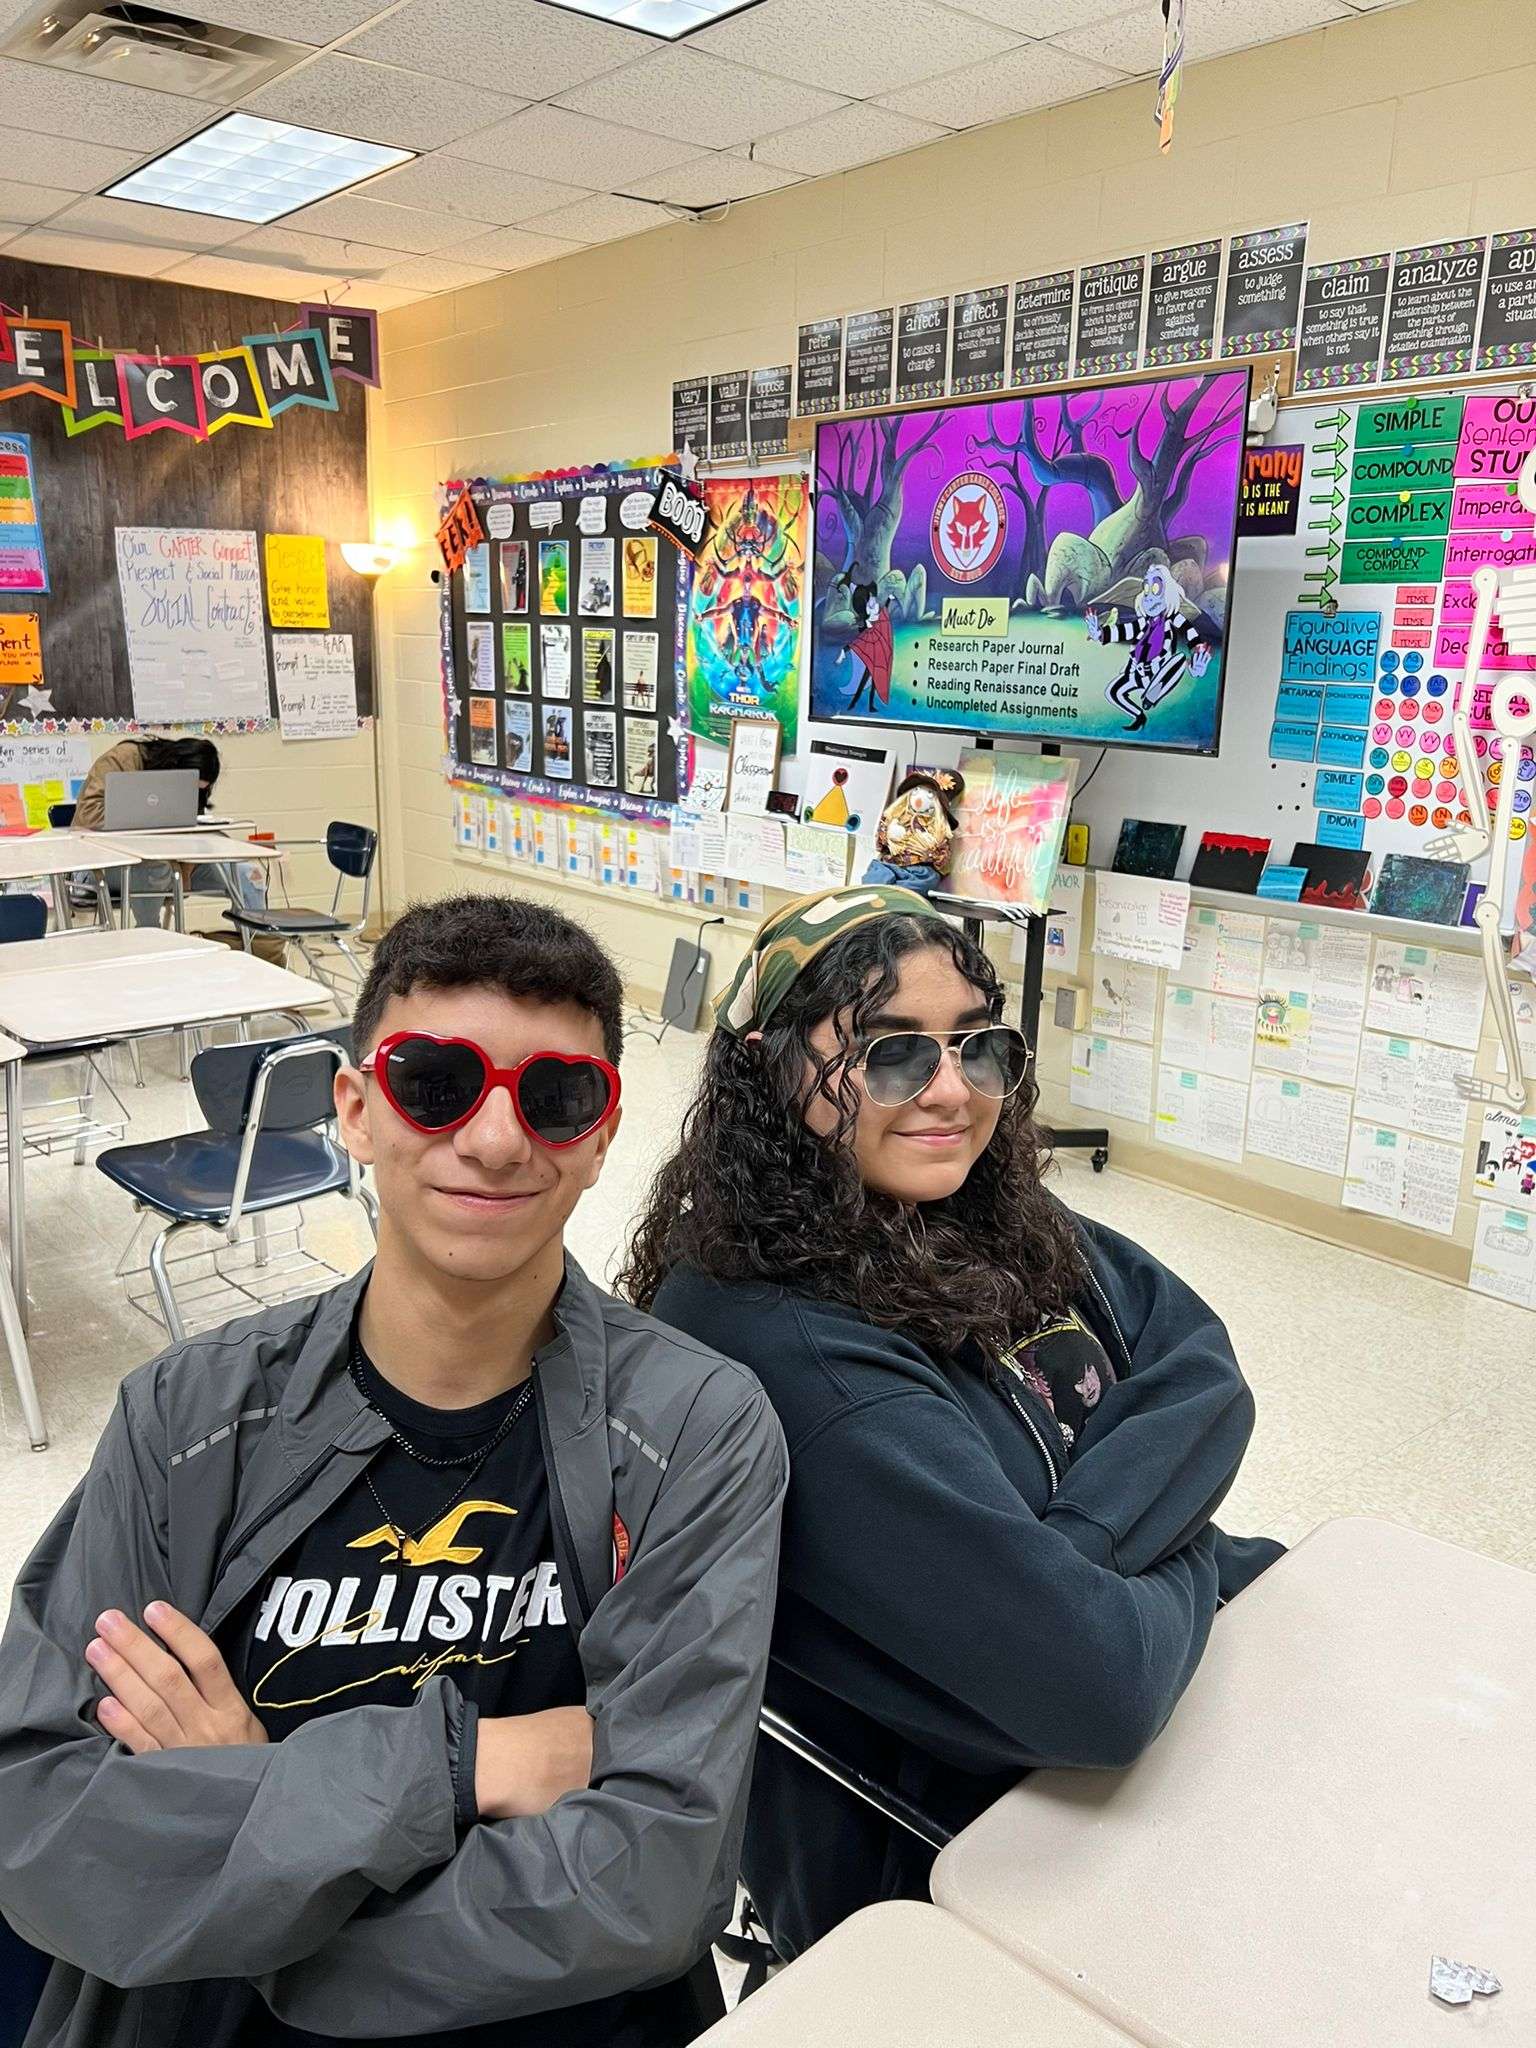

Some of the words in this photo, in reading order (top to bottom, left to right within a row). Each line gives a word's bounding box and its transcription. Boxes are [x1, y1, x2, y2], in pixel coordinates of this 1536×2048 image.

[1239, 243, 1294, 269] assess
[1509, 248, 1536, 273] ap
[1163, 259, 1206, 283] argue
[1398, 258, 1478, 287] analyze
[1085, 274, 1138, 298] critique
[1244, 279, 1254, 289] to
[1256, 273, 1283, 289] judge
[1322, 275, 1369, 299] claim
[1491, 283, 1502, 294] to
[1505, 280, 1523, 292] use
[1016, 288, 1071, 310] determine
[1155, 294, 1162, 304] to
[1164, 290, 1179, 304] give
[1180, 285, 1212, 298] reasons
[1238, 286, 1286, 305] something
[1398, 297, 1406, 306] to
[1408, 294, 1429, 305] learn
[1431, 290, 1456, 302] about
[1458, 287, 1472, 298] the
[1498, 299, 1506, 308] a
[963, 301, 998, 323] effect
[1081, 308, 1088, 316] to
[1089, 304, 1104, 315] form
[1105, 303, 1114, 312] an
[1115, 299, 1139, 311] opinion
[1105, 313, 1116, 322] the
[1118, 310, 1133, 323] good
[1157, 307, 1164, 316] in
[1165, 303, 1184, 315] favor
[1187, 301, 1195, 310] of
[1197, 299, 1206, 309] or
[1320, 309, 1328, 319] to
[1330, 307, 1345, 318] say
[1347, 303, 1367, 315] that
[1392, 303, 1440, 320] relationship
[1441, 299, 1475, 312] between
[905, 311, 941, 331] affect
[1094, 326, 1106, 336] bad
[1108, 323, 1127, 335] parts
[1165, 313, 1195, 328] against
[1305, 316, 1348, 334] something
[1349, 318, 1357, 327] is
[1360, 315, 1378, 325] true
[1408, 318, 1421, 327] the
[1422, 314, 1446, 329] parts
[1447, 312, 1457, 322] of
[1160, 324, 1199, 340] something
[1302, 335, 1324, 346] when
[1325, 331, 1353, 344] others
[1354, 328, 1370, 340] say
[1372, 327, 1379, 337] it
[1393, 326, 1433, 341] something
[1435, 322, 1468, 336] through
[903, 347, 911, 358] to
[912, 344, 934, 356] cause
[935, 343, 941, 353] a
[1090, 335, 1124, 348] something
[1326, 346, 1334, 356] is
[1336, 343, 1350, 354] not
[1388, 341, 1418, 353] detailed
[1420, 334, 1471, 349] examination
[15, 317, 354, 413] ELCOME
[907, 358, 935, 372] change
[680, 389, 701, 405] vary
[719, 382, 740, 399] valid
[1373, 407, 1445, 433] SIMPLE
[1494, 399, 1536, 423] OU
[1462, 422, 1536, 446] Senten
[1354, 458, 1454, 480] COMPOUND
[1252, 485, 1260, 498] IS
[1265, 483, 1281, 497] THE
[658, 481, 705, 544] BOO!
[1246, 503, 1255, 516] IS
[1258, 501, 1289, 516] MEANT
[1351, 501, 1446, 524] COMPLEX
[1458, 498, 1528, 518] Impera
[439, 500, 475, 570] EEK!
[122, 534, 151, 559] Our
[1356, 548, 1430, 560] COMPOUND-
[1363, 559, 1420, 571] COMPLEX
[126, 560, 175, 590] Respect
[944, 608, 975, 629] Must
[978, 608, 996, 629] Do
[1288, 615, 1379, 638] Figurative
[929, 639, 979, 653] Research
[983, 640, 1015, 656] Paper
[1018, 641, 1064, 655] Journal
[1285, 639, 1378, 656] LANGUAGE
[275, 652, 299, 676] Prompt
[928, 658, 977, 672] Research
[982, 660, 1014, 676] Paper
[1018, 661, 1046, 675] Final
[1050, 662, 1080, 676] Draft
[1288, 654, 1368, 680] Findings
[927, 677, 970, 694] Reading
[974, 680, 1047, 695] Renaissance
[1051, 683, 1078, 697] Quiz
[1280, 687, 1321, 697] METAPHOR
[279, 693, 306, 717] Prompt
[729, 692, 759, 705] THOR
[926, 696, 997, 713] Uncompleted
[1000, 701, 1078, 718] Assignments
[709, 703, 777, 720] RAGNAROK
[1322, 731, 1366, 742] OXYMORON
[22, 746, 50, 756] series
[56, 740, 68, 756] of
[1324, 772, 1357, 785] SIMILE
[1326, 815, 1357, 828] IDIOM
[1484, 1110, 1521, 1129] alma
[254, 1561, 566, 1648] HOLLISTER
